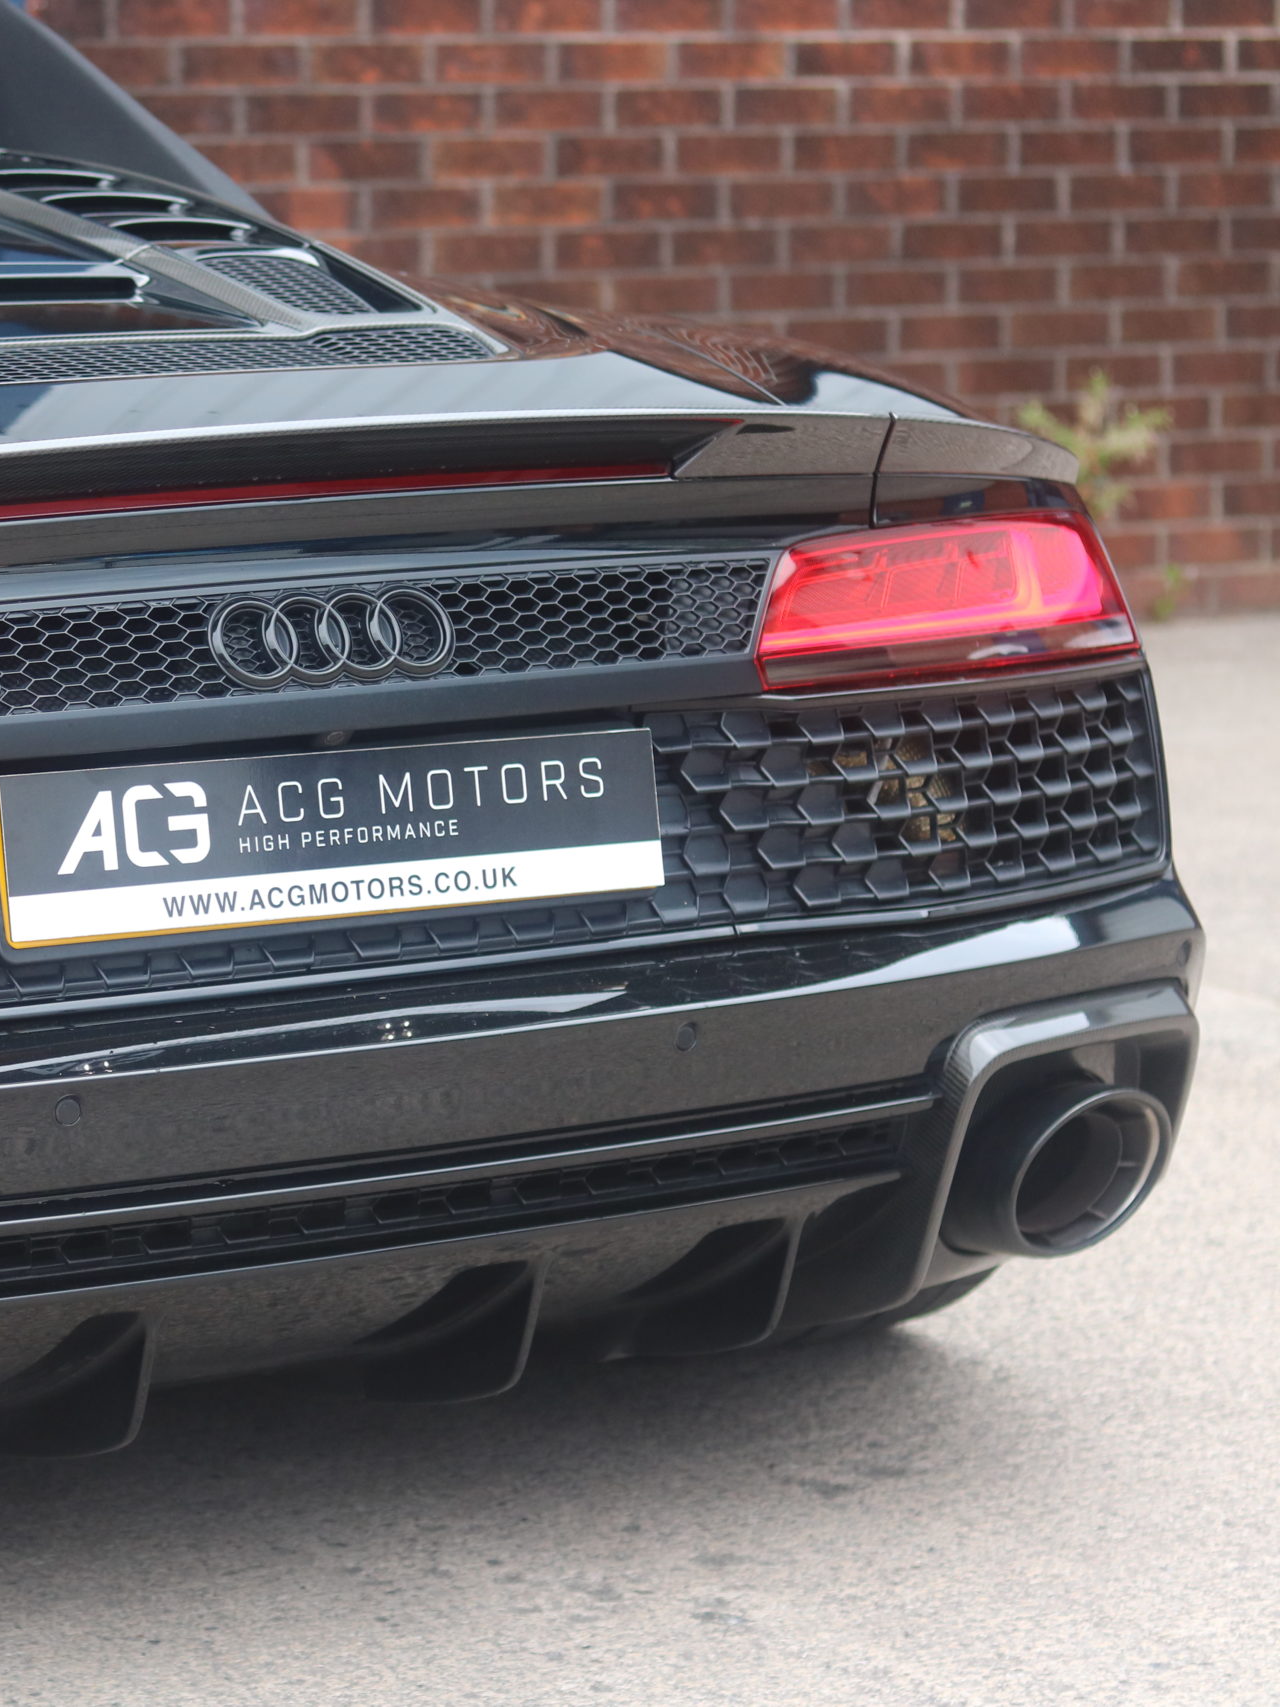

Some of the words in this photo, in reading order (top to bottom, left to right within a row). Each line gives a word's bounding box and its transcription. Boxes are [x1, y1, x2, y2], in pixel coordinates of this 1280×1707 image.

[238, 777, 345, 827] ACG
[378, 757, 605, 815] MOTORS
[57, 781, 211, 876] ACG
[239, 833, 290, 854] HIGH
[301, 819, 460, 849] PERFORMANCE
[163, 866, 518, 918] WWW.ACGMOTORS.CO.UK
